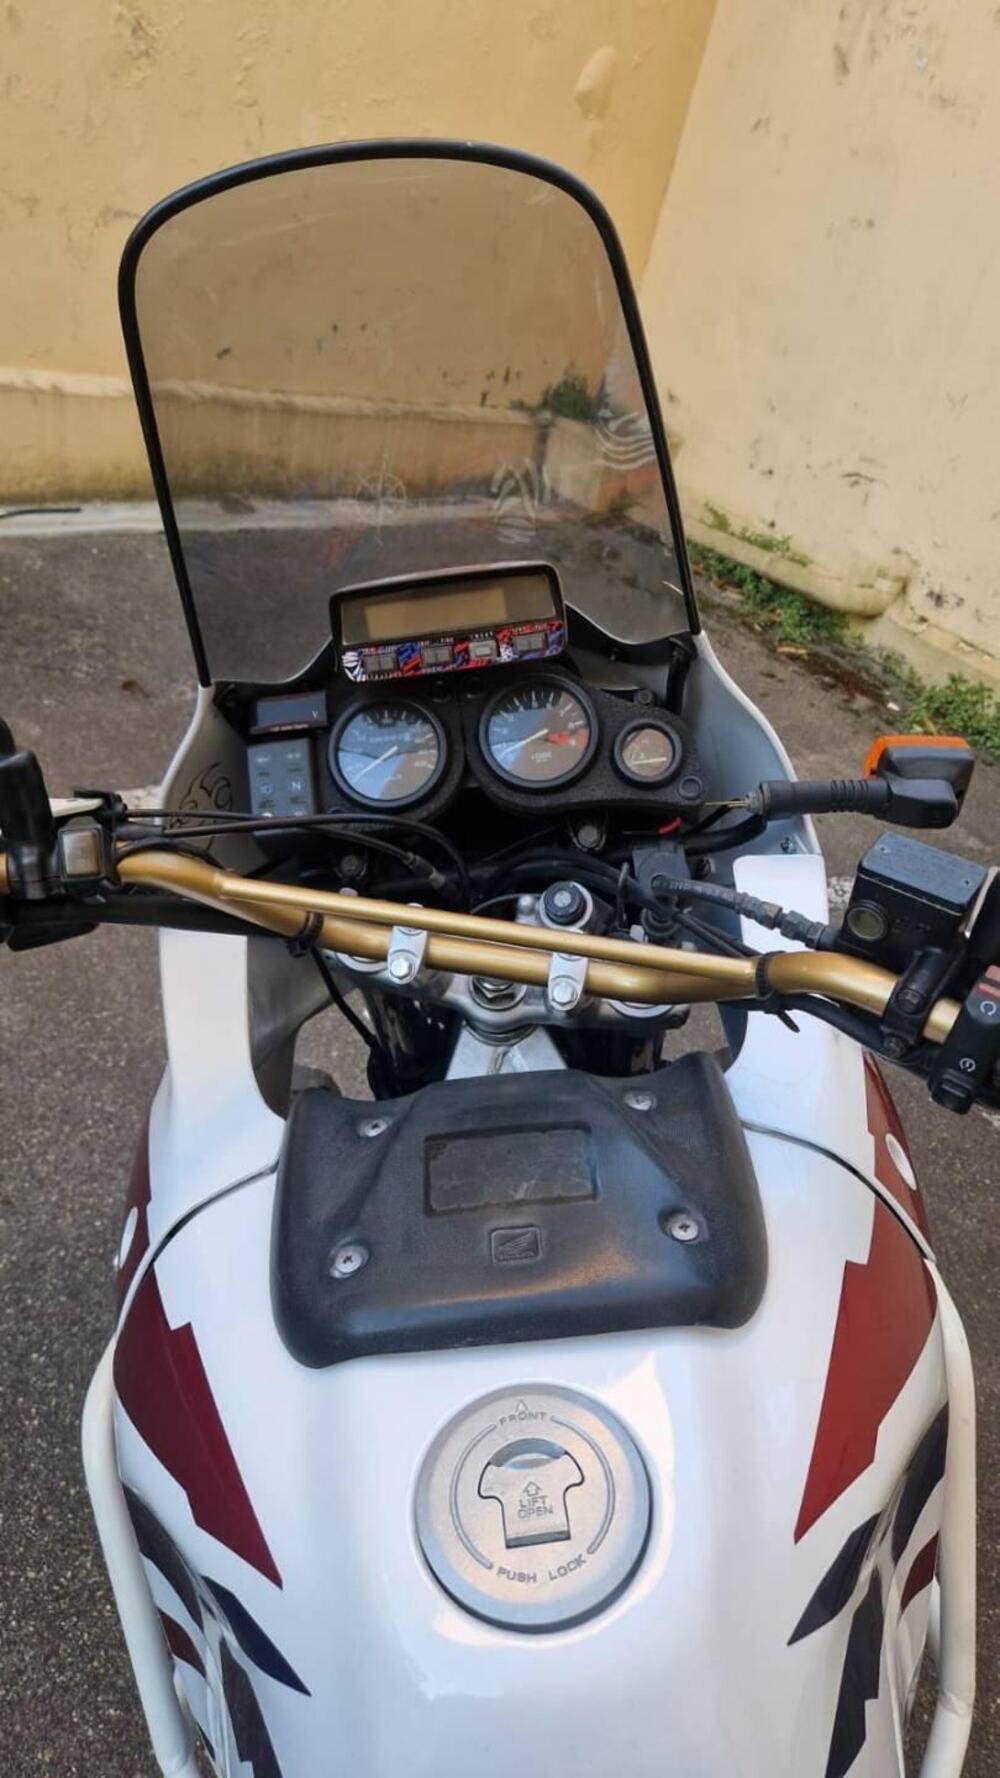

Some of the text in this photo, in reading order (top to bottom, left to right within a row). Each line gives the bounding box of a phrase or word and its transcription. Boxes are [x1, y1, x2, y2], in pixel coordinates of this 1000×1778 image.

[291, 781, 301, 791] N
[499, 1411, 547, 1426] FRONT
[519, 1495, 548, 1508] LIFT
[517, 1506, 553, 1519] OPEN
[496, 1554, 587, 1583] PUSH LOCK
